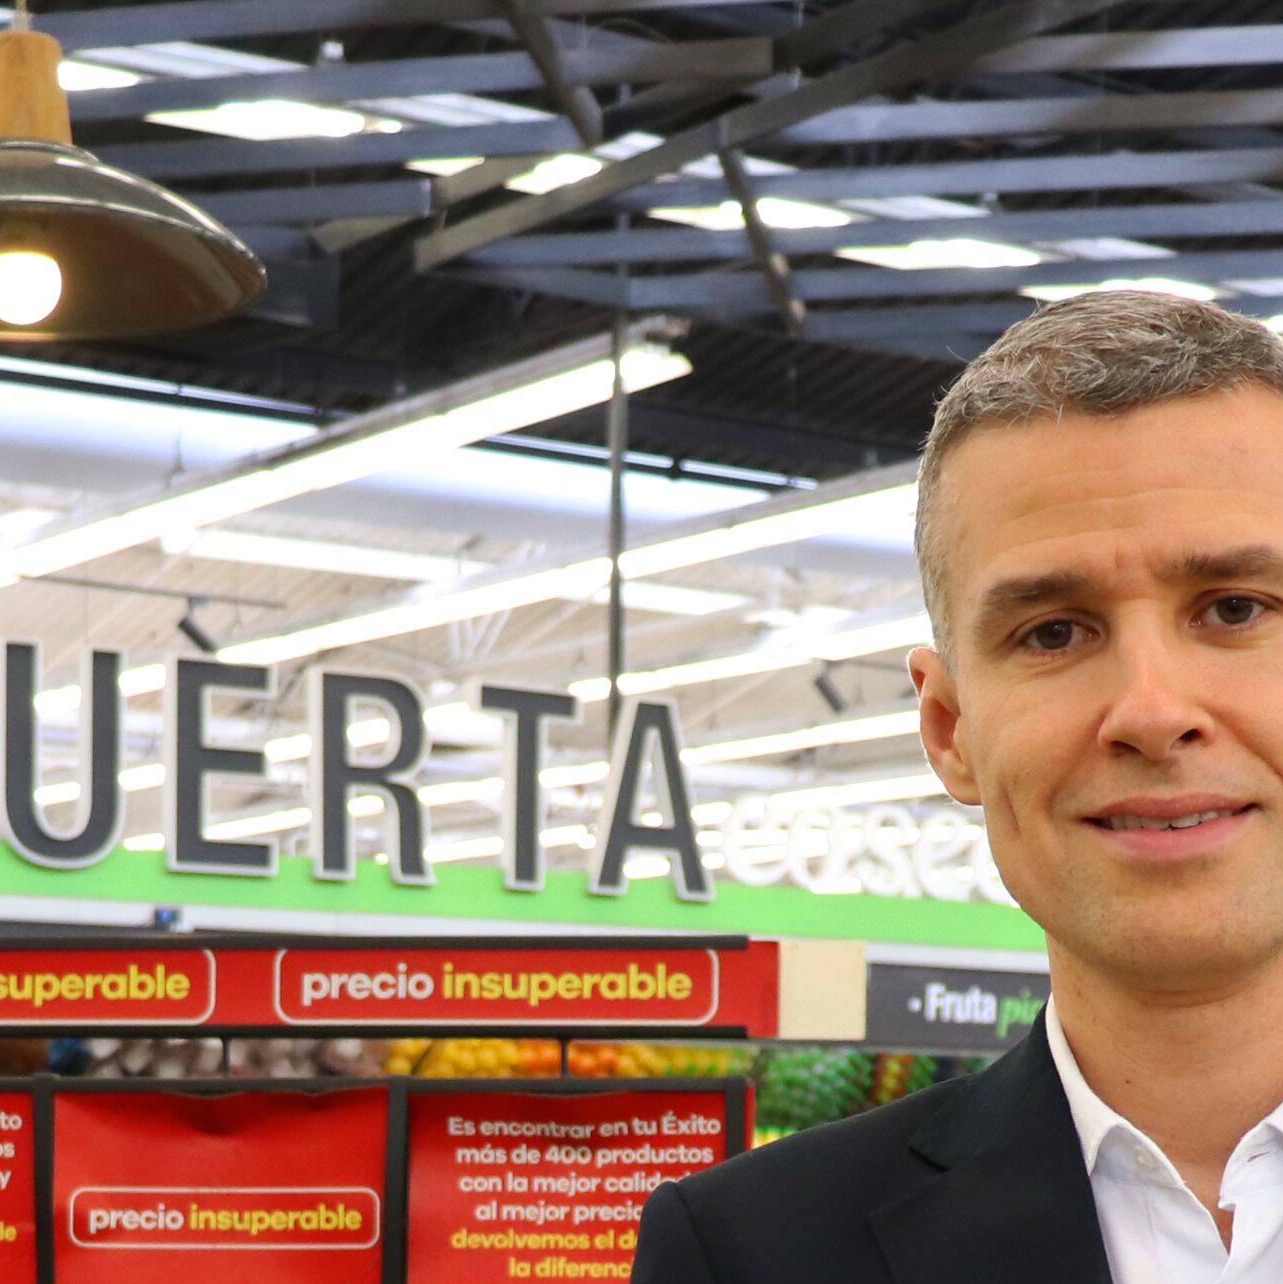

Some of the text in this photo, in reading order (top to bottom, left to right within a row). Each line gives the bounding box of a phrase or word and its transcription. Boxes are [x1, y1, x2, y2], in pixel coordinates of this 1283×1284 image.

[301, 962, 693, 1006] precio insuperable
[924, 983, 997, 1024] Fruta
[447, 1110, 722, 1140] Es encontrar en tu Éxito
[456, 1143, 714, 1167] más de 400 productos
[459, 1174, 503, 1192] con
[507, 1171, 528, 1192] la
[533, 1171, 601, 1196] mejor
[89, 1203, 362, 1235] precio insuperable
[475, 1200, 497, 1221] al
[502, 1200, 570, 1225] mejor
[450, 1228, 590, 1249] devolvemos
[594, 1229, 614, 1249] el
[508, 1256, 531, 1278] la
